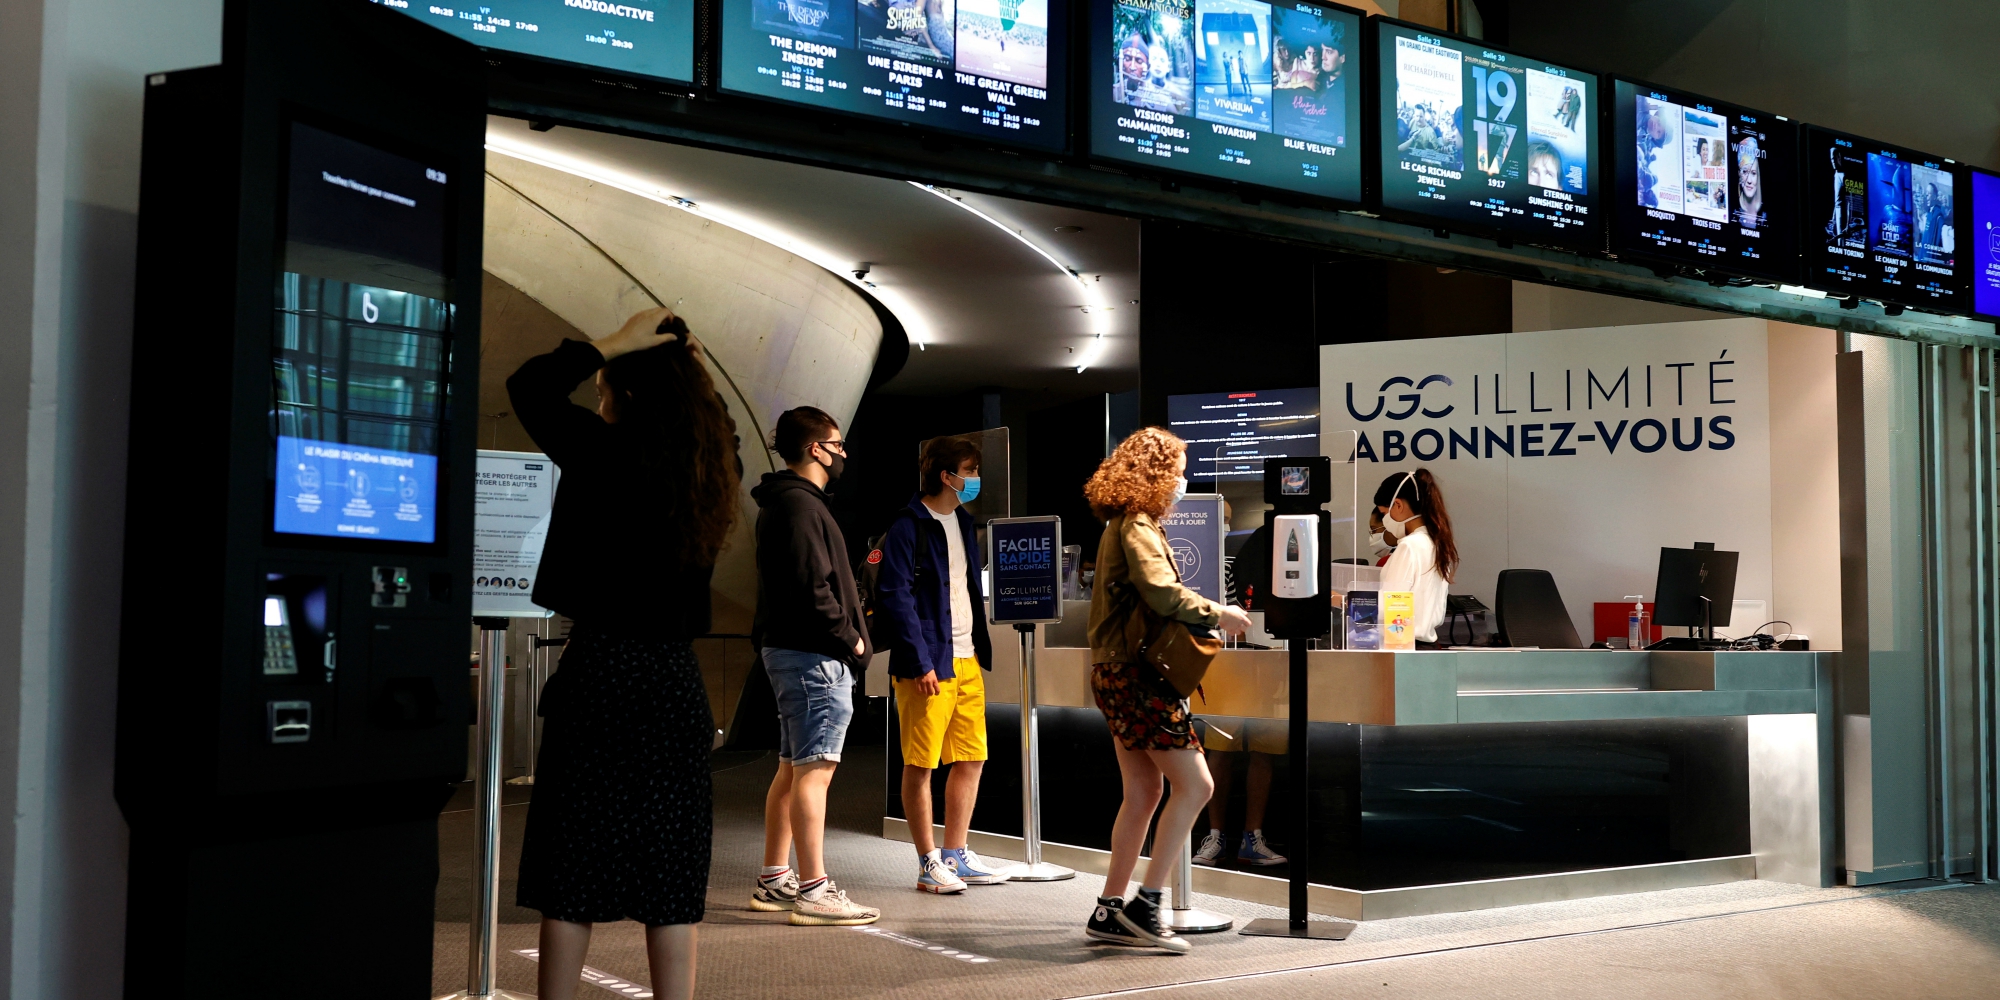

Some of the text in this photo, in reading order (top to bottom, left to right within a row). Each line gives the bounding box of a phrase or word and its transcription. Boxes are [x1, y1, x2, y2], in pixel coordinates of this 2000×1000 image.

[480, 6, 491, 14] VF
[797, 5, 830, 20] DEMON
[1296, 4, 1312, 14] Salle
[459, 11, 482, 22] 11:55
[788, 10, 820, 28] INSIDE
[604, 29, 616, 38] VO
[1417, 35, 1432, 44] Salle
[769, 35, 837, 58] THE DEMON
[782, 51, 824, 69] INSIDE
[1436, 49, 1460, 60] EASTWOOD
[1483, 51, 1497, 60] Salle
[792, 65, 802, 73] VO
[867, 54, 944, 80] UNE SIRENE A
[1403, 63, 1456, 82] RICHARD JEWELL
[1545, 66, 1558, 75] Salle
[888, 72, 923, 88] PARIS
[954, 72, 1046, 100] THE GREAT GREEN
[987, 92, 1016, 106] WALL
[1472, 66, 1517, 122] 19
[1214, 97, 1254, 114] VIVARIUM
[1134, 108, 1174, 124] VISIONS
[1117, 117, 1184, 139] CHAMANIQUES
[1212, 124, 1256, 140] VIVARIUM
[1284, 138, 1336, 156] BLUE VELVET
[1473, 119, 1518, 174] 17
[1401, 161, 1462, 180] LE CAS RICHARD
[1417, 174, 1446, 188] JEWELL
[1488, 178, 1506, 188] 1917
[1845, 179, 1864, 190] GRAN
[1544, 189, 1573, 202] ETERNAL
[1528, 196, 1588, 214] SUNSHINE OF THE
[1647, 209, 1675, 221] MOSQUITO
[1692, 218, 1721, 230] TROIS ETES
[1741, 228, 1760, 238] WOMAN
[1882, 230, 1900, 242] LOUP
[1828, 246, 1864, 258] GRAN TORINO
[1882, 257, 1899, 266] CHANT
[1885, 266, 1898, 274] LOUP
[1923, 264, 1952, 276] COMMUNION
[1346, 349, 1736, 422] UGC ILLIMITÉ
[1348, 416, 1736, 464] ABONNEZ-VOUS
[999, 537, 1050, 552] FACILE
[1000, 551, 1050, 564] RAPIDE
[1018, 585, 1052, 594] ILLIMITÉ
